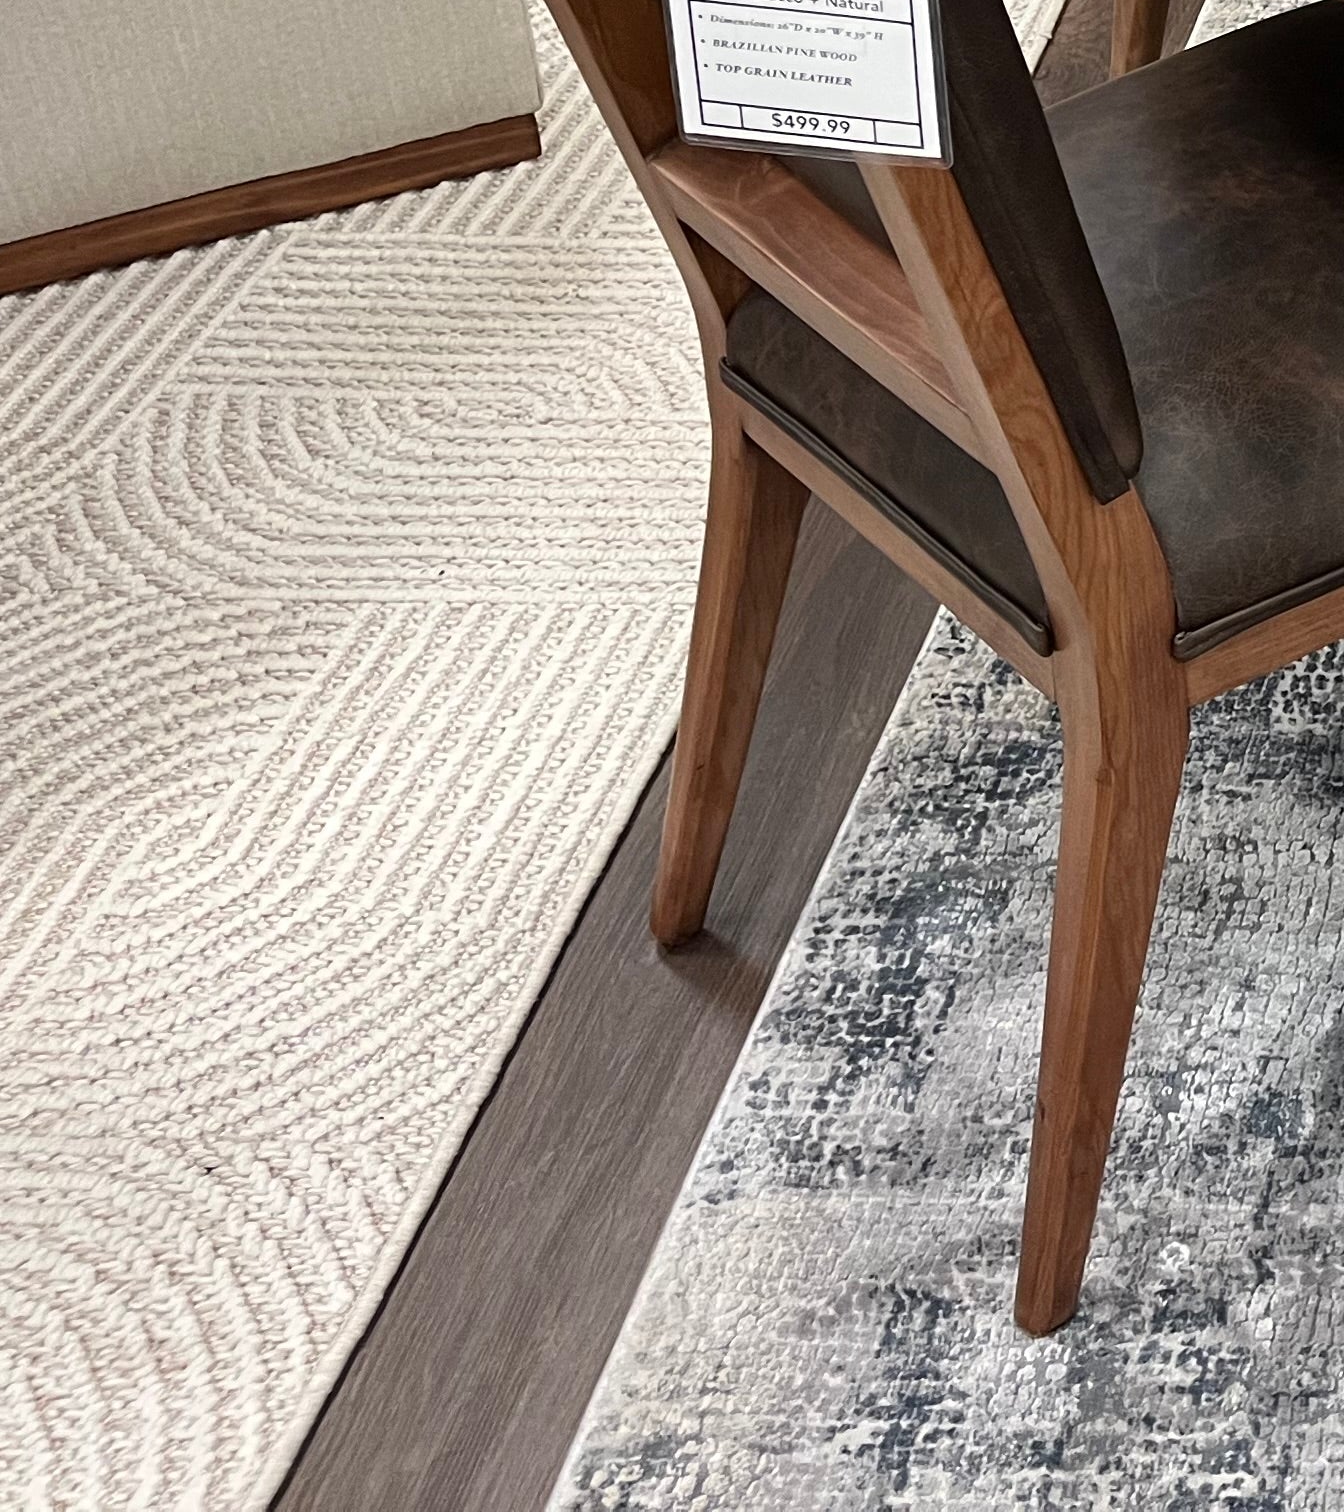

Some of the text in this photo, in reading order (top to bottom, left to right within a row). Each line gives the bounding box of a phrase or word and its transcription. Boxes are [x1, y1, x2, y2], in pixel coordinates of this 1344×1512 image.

[712, 39, 858, 62] BRAZILIAN PINE WOOD
[715, 63, 853, 87] TOP GRAIN LEATHER
[771, 112, 851, 135] $499.99
